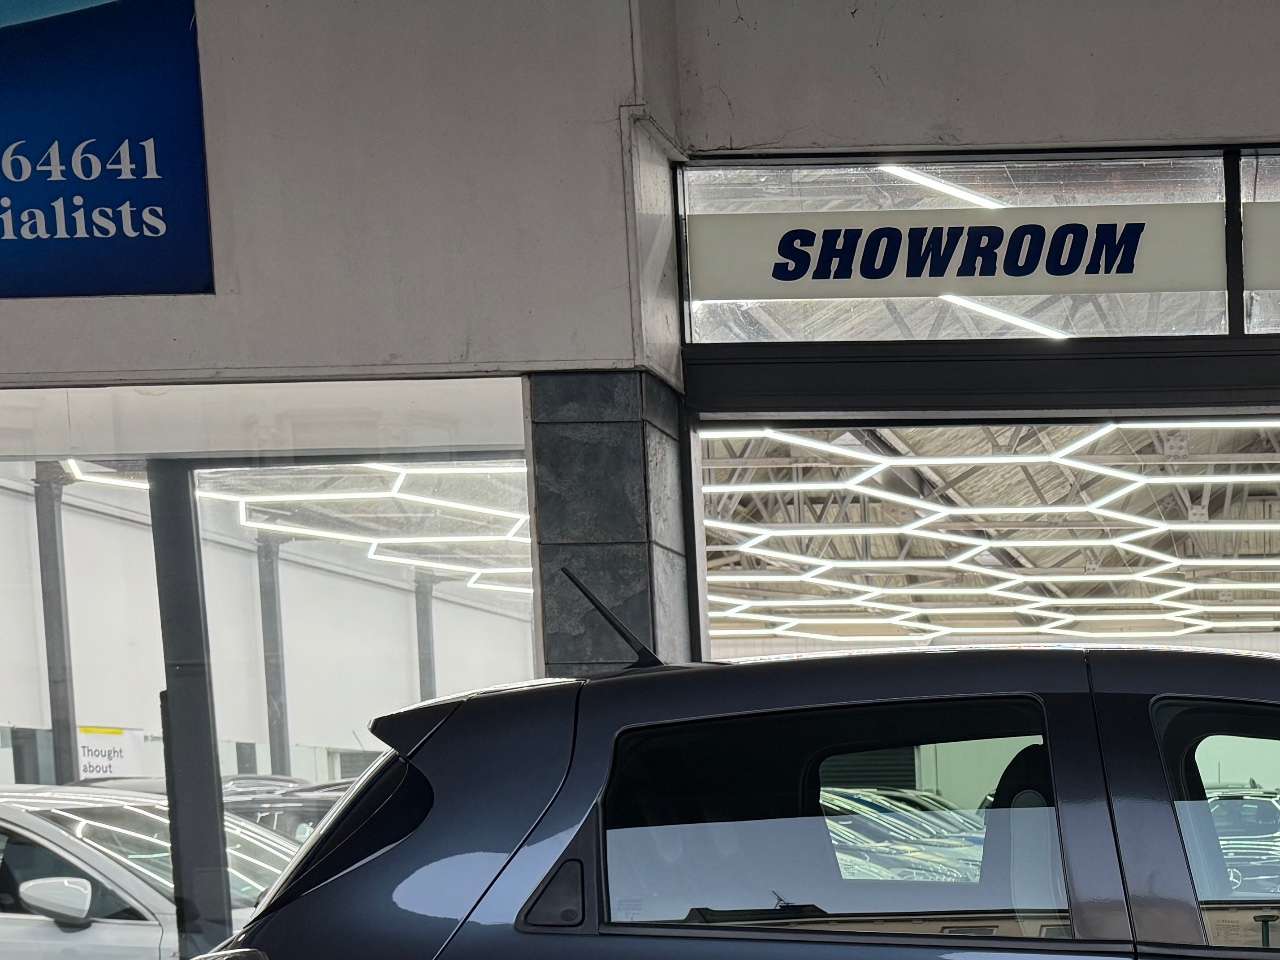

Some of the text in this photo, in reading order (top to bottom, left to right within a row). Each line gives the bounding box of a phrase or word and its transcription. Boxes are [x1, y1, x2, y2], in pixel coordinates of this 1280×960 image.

[1, 137, 163, 182] 64641
[0, 195, 167, 240] ialists
[771, 222, 1146, 282] SHOWROOM
[80, 745, 124, 761] Thought
[82, 762, 113, 774] about
